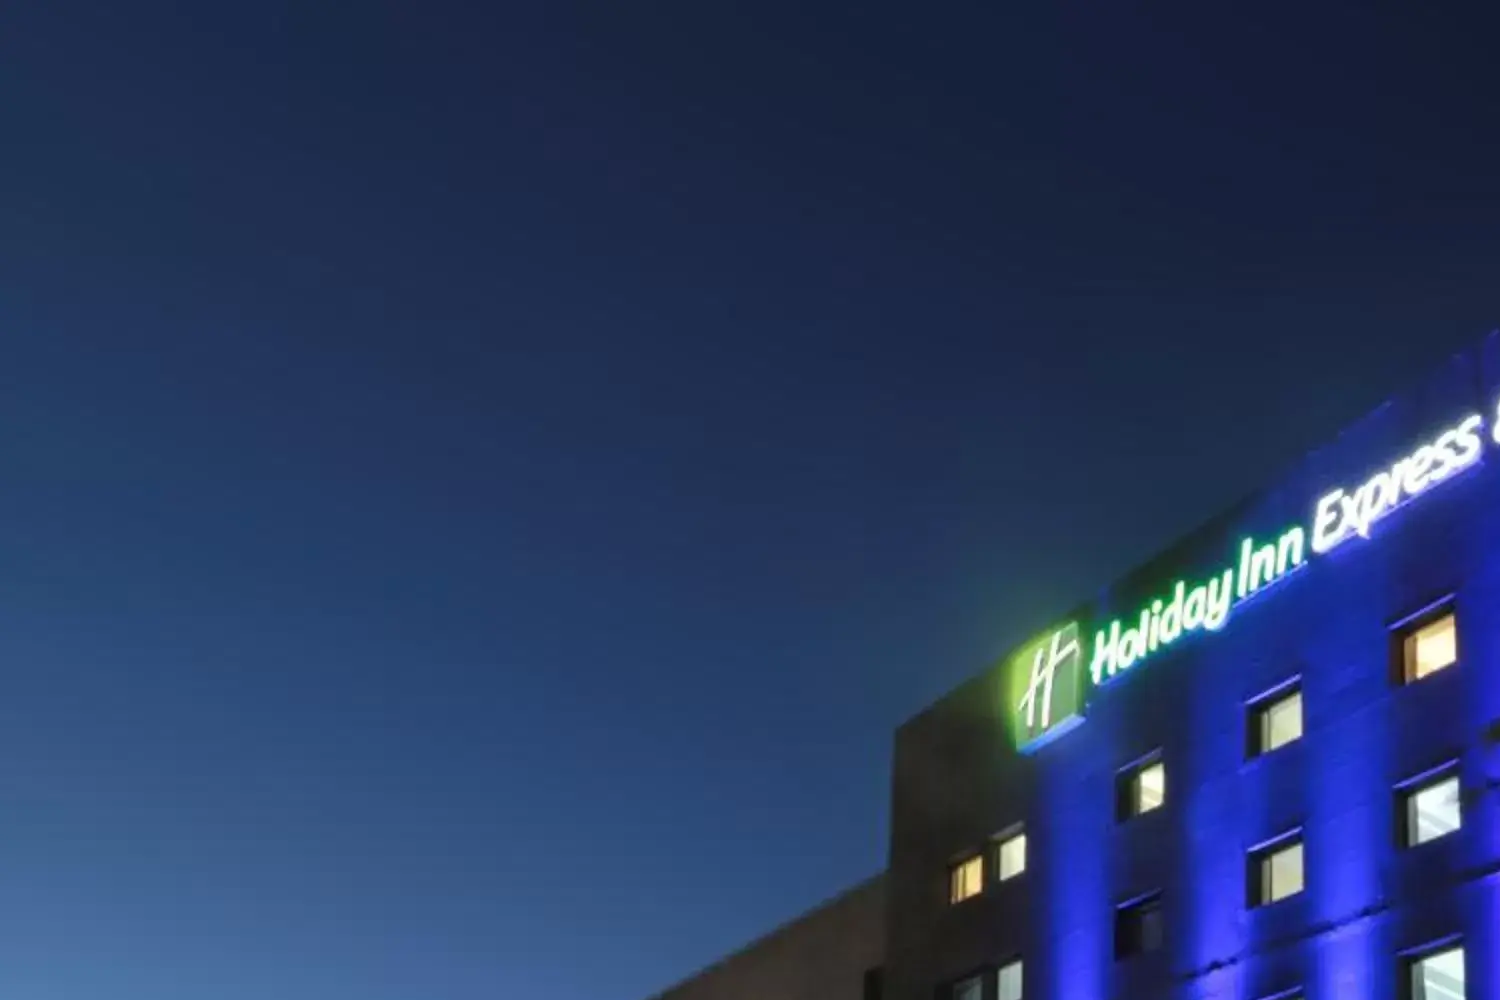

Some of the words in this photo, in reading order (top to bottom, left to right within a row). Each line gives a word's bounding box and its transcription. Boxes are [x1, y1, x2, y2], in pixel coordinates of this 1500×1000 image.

[1089, 568, 1233, 686] Holiday
[1237, 526, 1304, 598] Inn
[1311, 414, 1482, 553] Express
